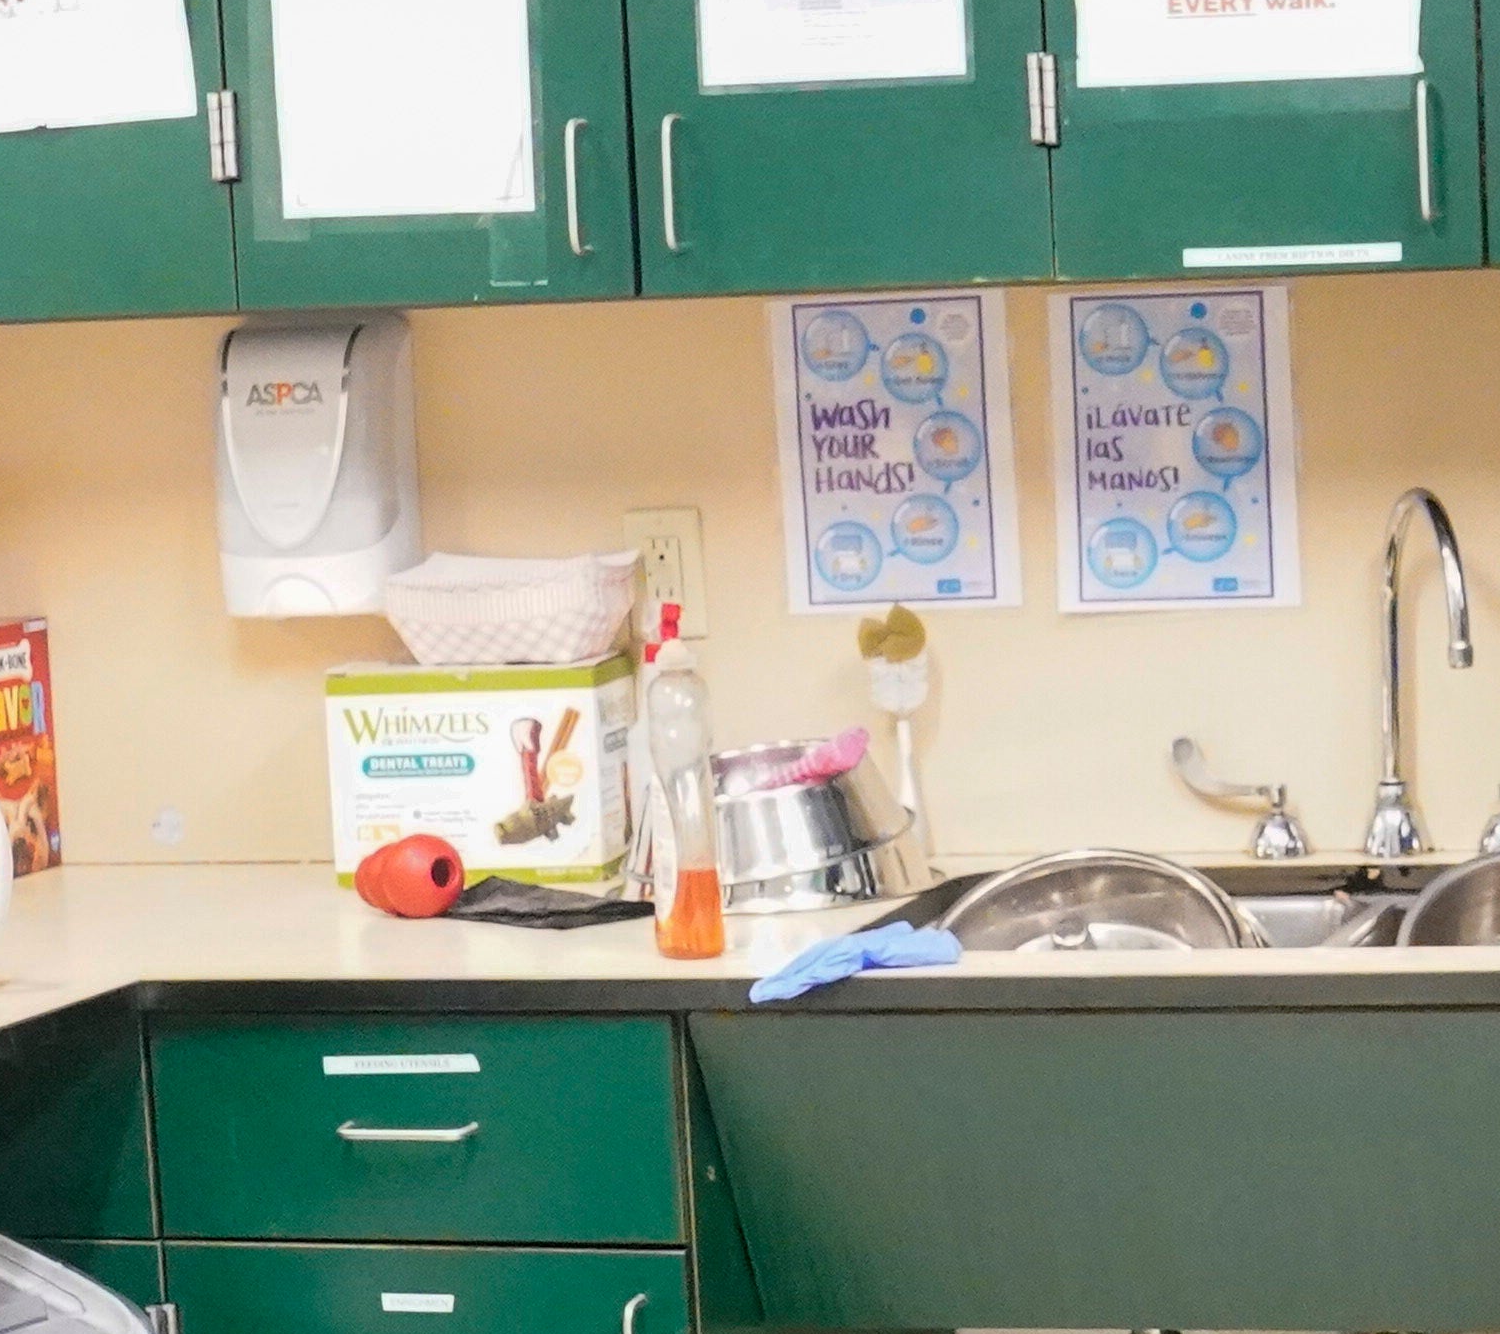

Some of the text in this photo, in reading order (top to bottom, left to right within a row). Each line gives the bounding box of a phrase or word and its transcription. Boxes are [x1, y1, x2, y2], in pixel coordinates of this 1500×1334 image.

[1217, 251, 1256, 263] CANINE
[245, 380, 324, 407] ASPCA
[369, 755, 468, 772] DENTAL TREATS
